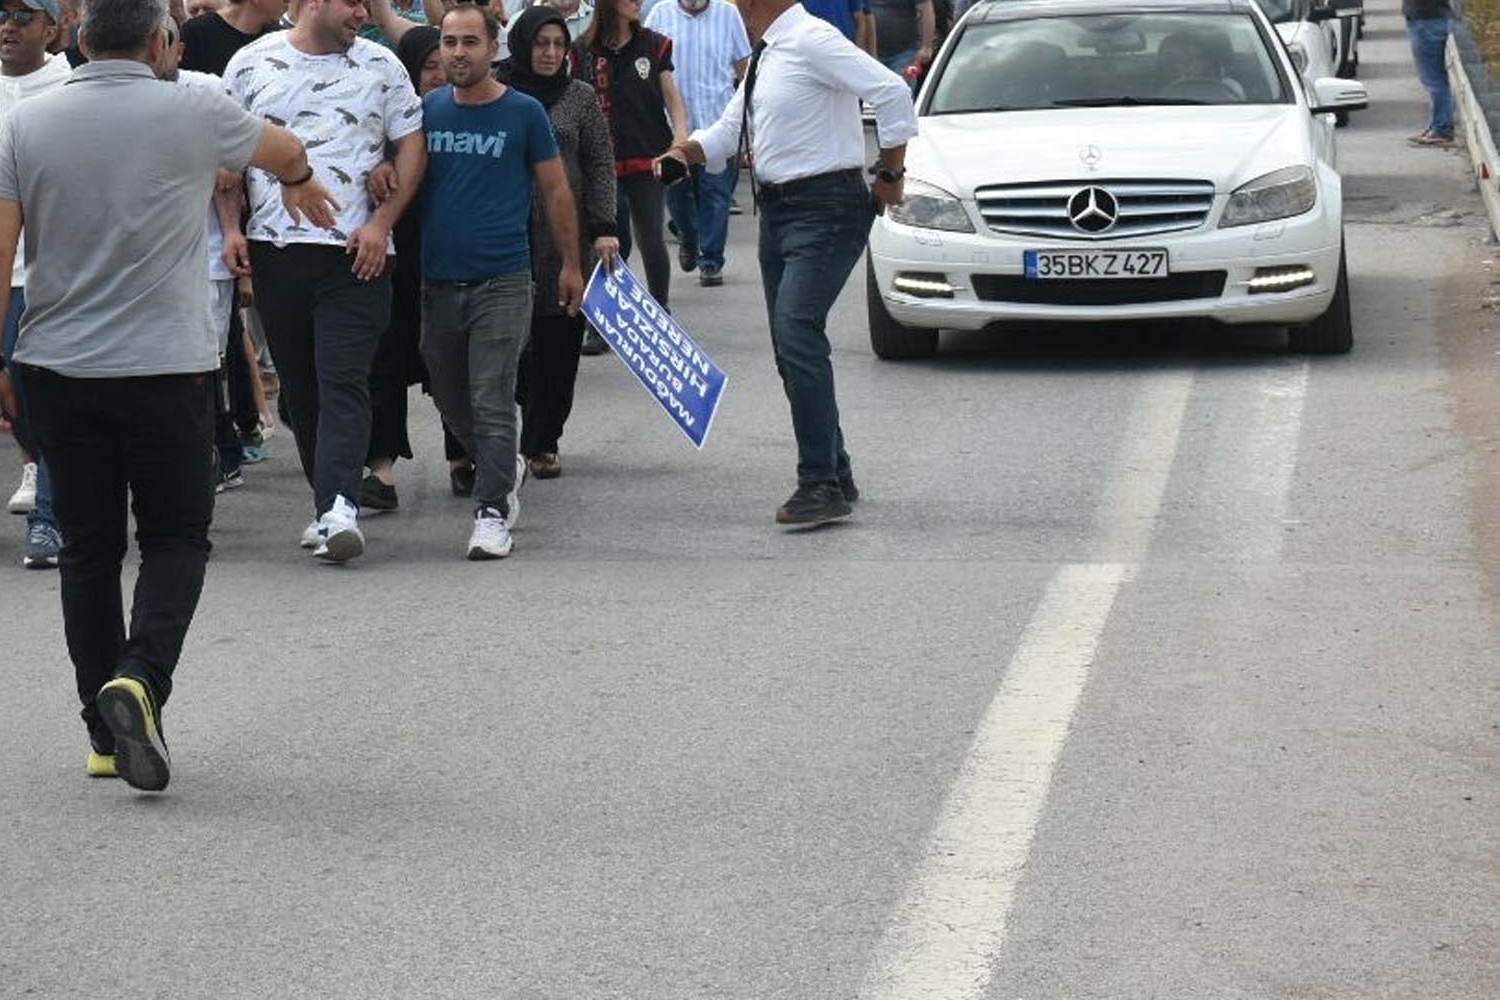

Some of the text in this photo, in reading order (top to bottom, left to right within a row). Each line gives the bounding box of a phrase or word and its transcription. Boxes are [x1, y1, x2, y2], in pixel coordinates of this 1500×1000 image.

[426, 131, 507, 158] mavi
[594, 307, 695, 427] MAĞDURLAR
[604, 277, 709, 397] HIRSIZLAR
[616, 313, 683, 393] BURADA
[630, 283, 710, 376] NEREDE
